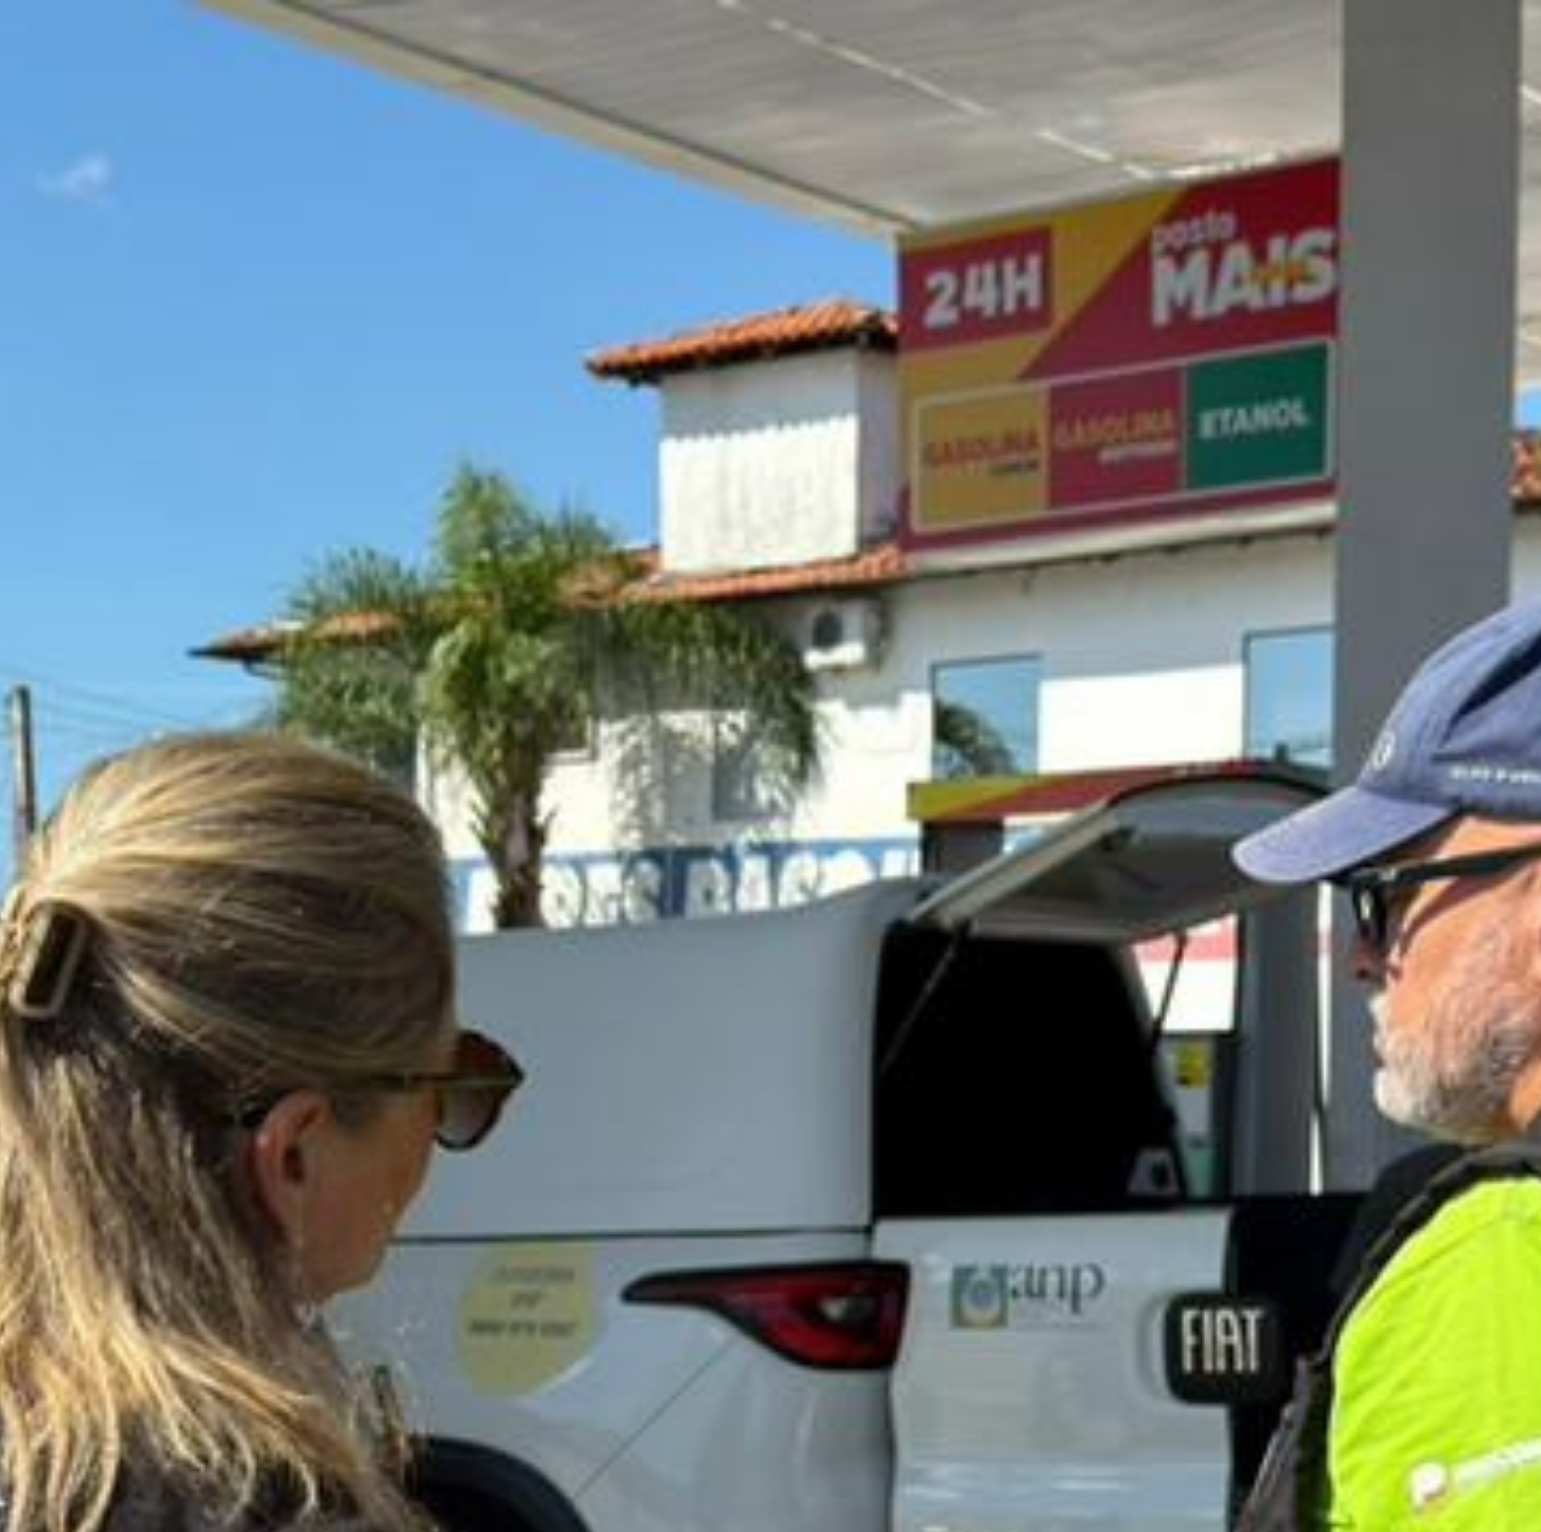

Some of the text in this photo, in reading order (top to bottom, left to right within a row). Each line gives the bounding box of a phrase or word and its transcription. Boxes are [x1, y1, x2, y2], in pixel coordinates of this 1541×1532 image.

[923, 254, 1043, 329] 24H
[1152, 227, 1337, 328] MAIS
[1199, 397, 1310, 441] ETANOL
[1180, 1308, 1264, 1376] FIAT
